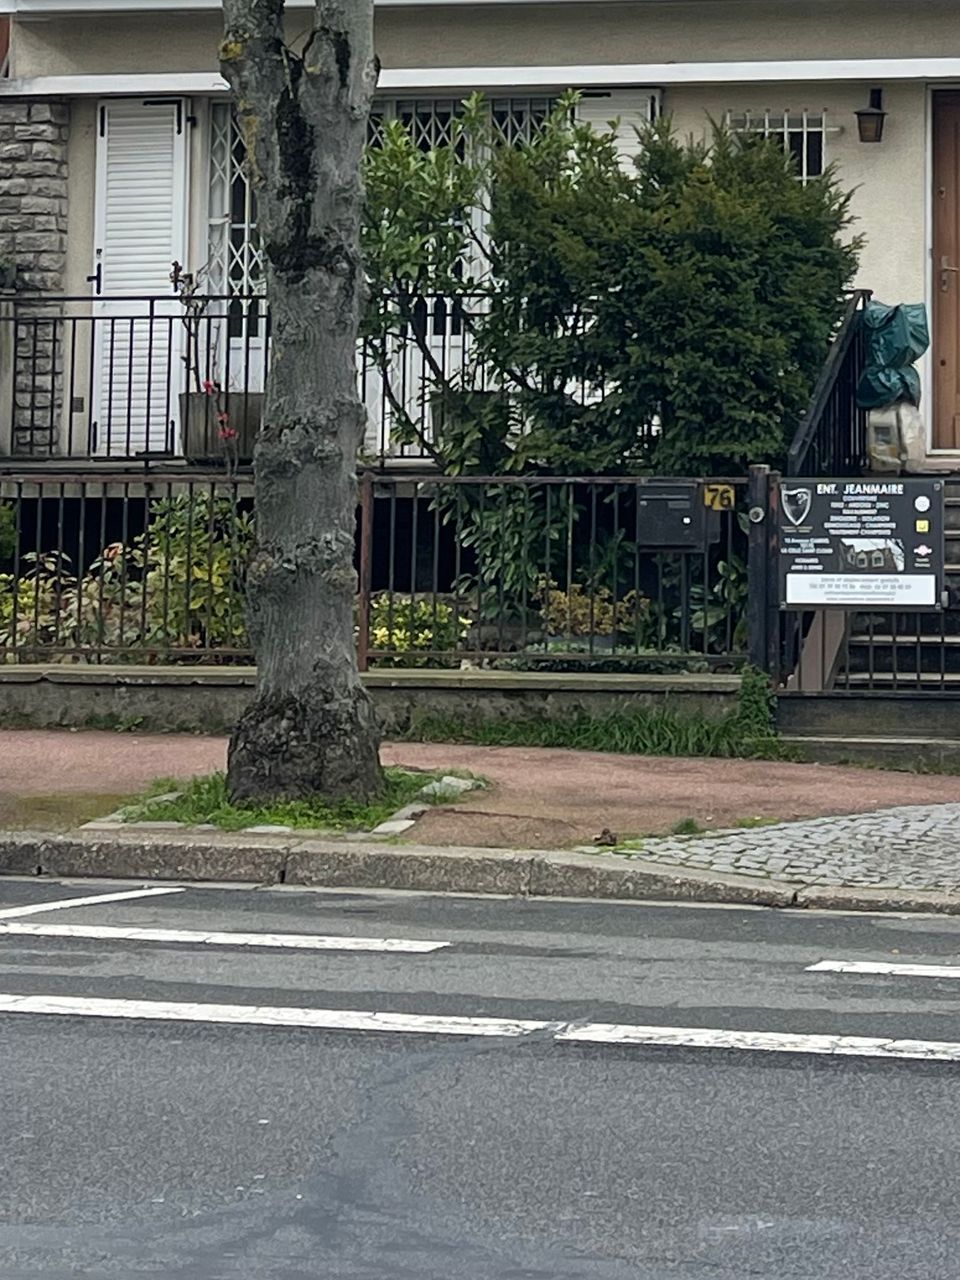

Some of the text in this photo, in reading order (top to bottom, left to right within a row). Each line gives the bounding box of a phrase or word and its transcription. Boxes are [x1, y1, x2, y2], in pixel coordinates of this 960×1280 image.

[816, 483, 904, 495] ENT. JEANMAIRE
[707, 487, 732, 508] 76
